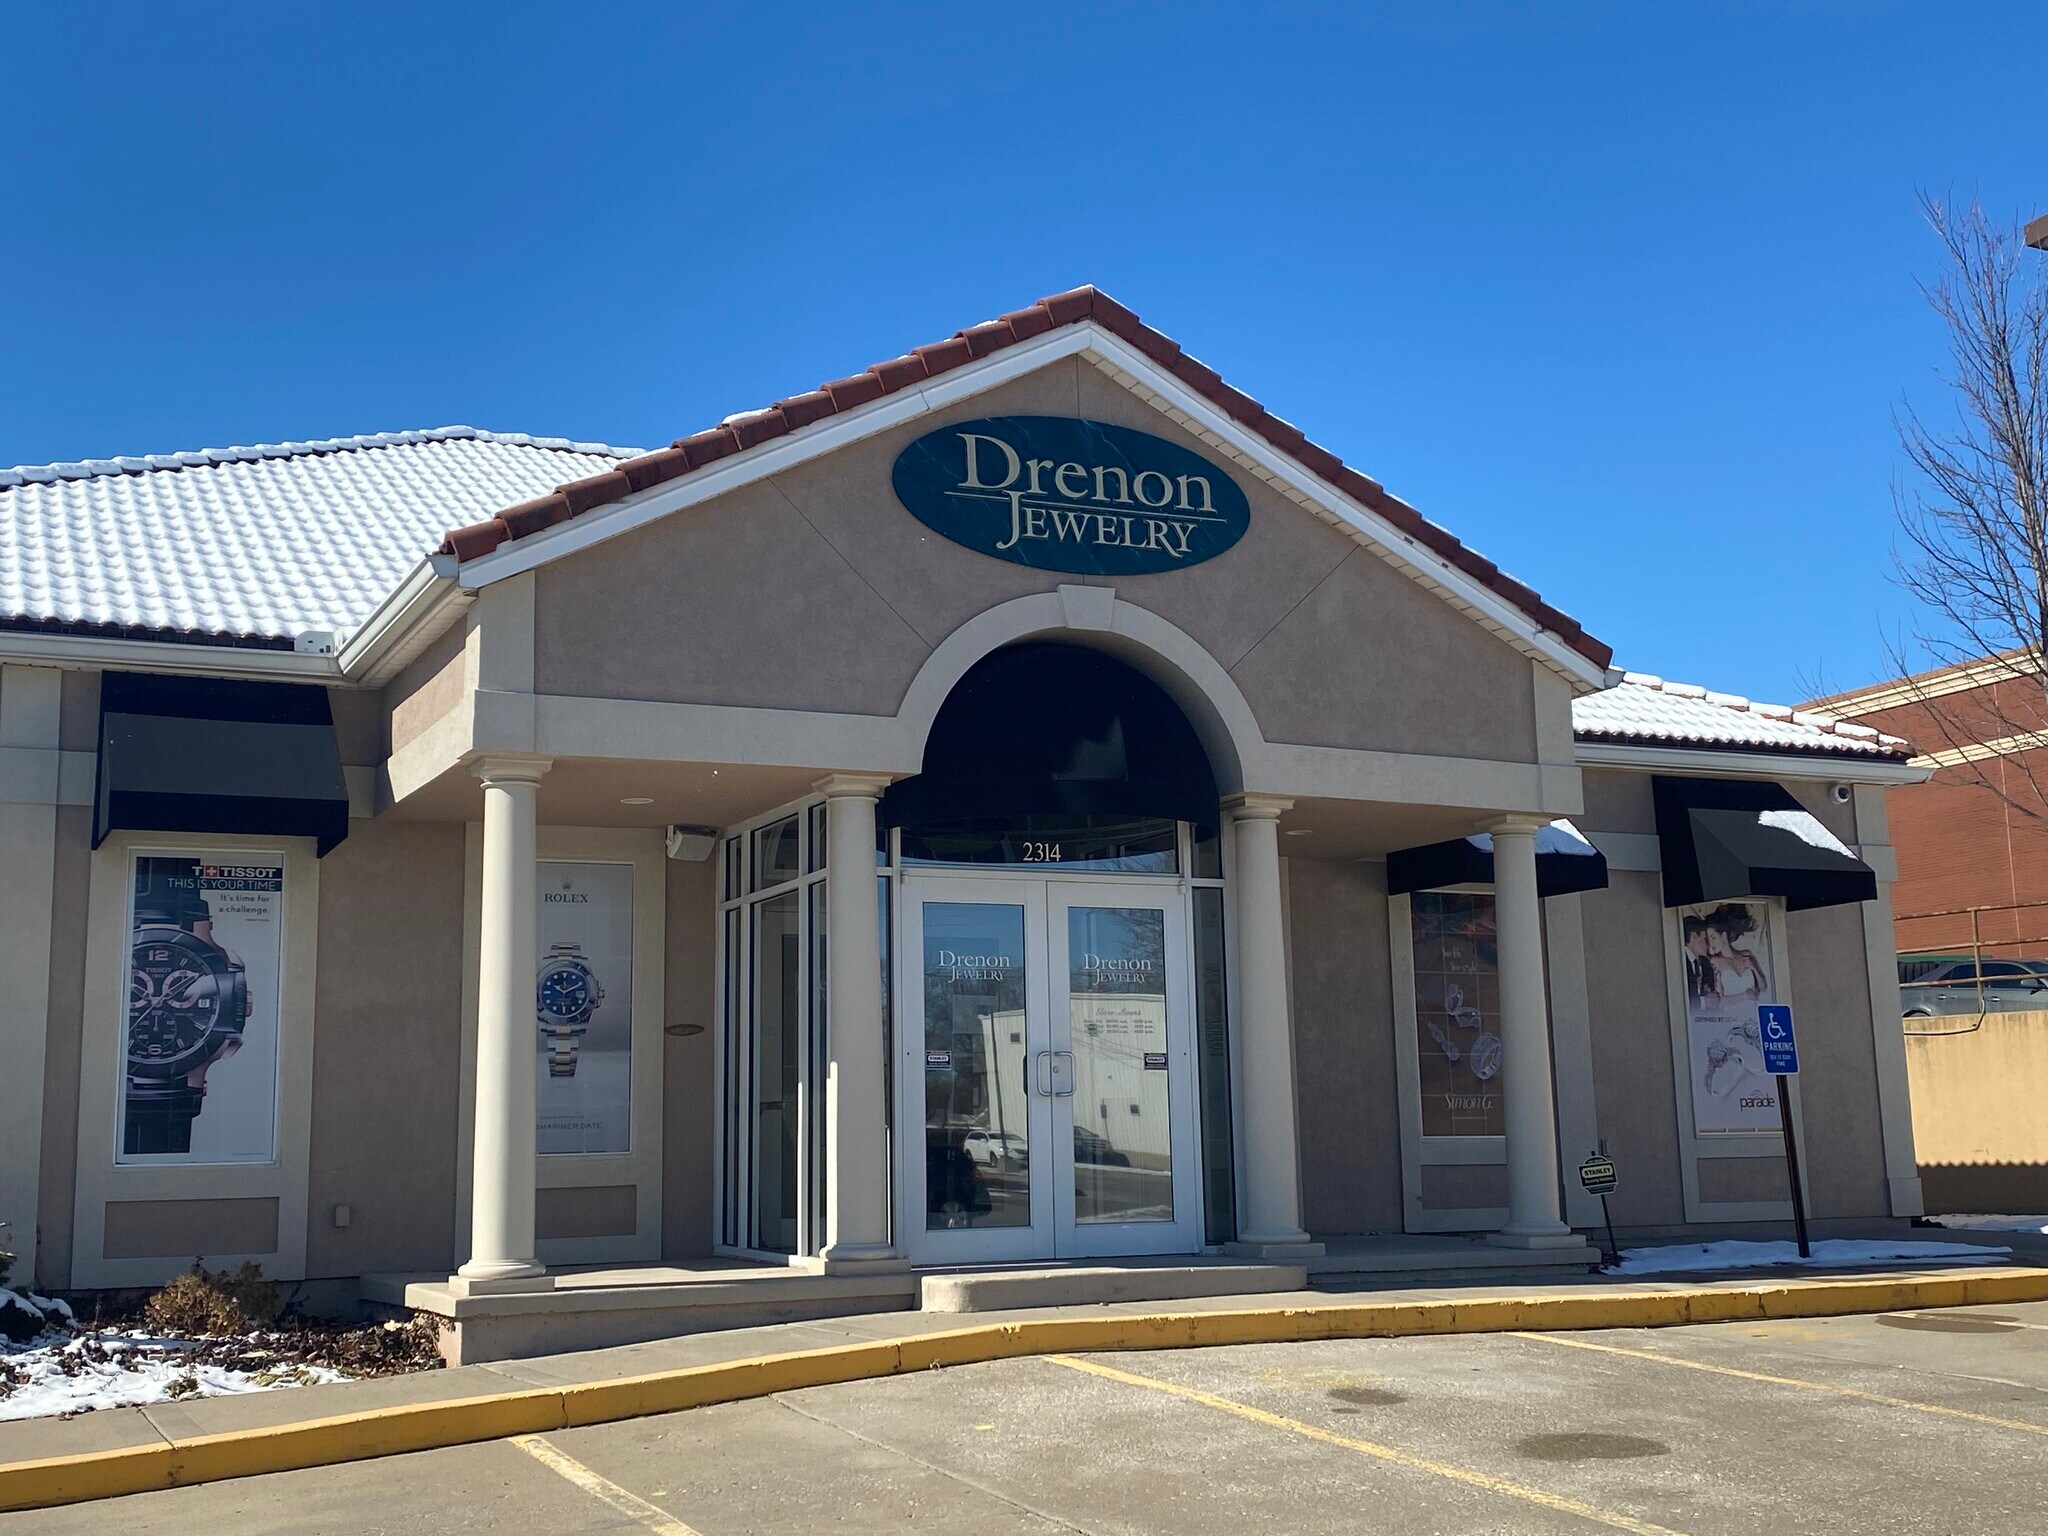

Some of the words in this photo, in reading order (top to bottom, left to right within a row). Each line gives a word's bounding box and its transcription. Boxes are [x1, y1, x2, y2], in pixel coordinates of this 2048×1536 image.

[956, 432, 1218, 514] Drenon
[995, 489, 1198, 558] JEWELRY
[1022, 842, 1062, 862] 2314
[220, 866, 276, 878] TISSOT
[167, 878, 194, 888] THIS
[197, 879, 206, 889] IS
[210, 879, 244, 890] YOUR
[245, 880, 276, 891] TIME
[220, 894, 234, 902] It's
[236, 894, 255, 902] time
[257, 894, 270, 903] for
[544, 893, 589, 903] ROLEX
[225, 905, 270, 915] challenge.
[148, 950, 169, 961] 12
[939, 950, 1011, 968] Drenon
[1084, 953, 1153, 971] Drenon
[947, 965, 1006, 983] JEWELRY
[1092, 968, 1147, 986] JEWELRY
[1764, 1041, 1794, 1052] PARKING
[1442, 1092, 1481, 1111] Simon
[1482, 1093, 1494, 1110] G.
[1739, 1092, 1775, 1112] parade
[1583, 1167, 1611, 1177] STANLEY
